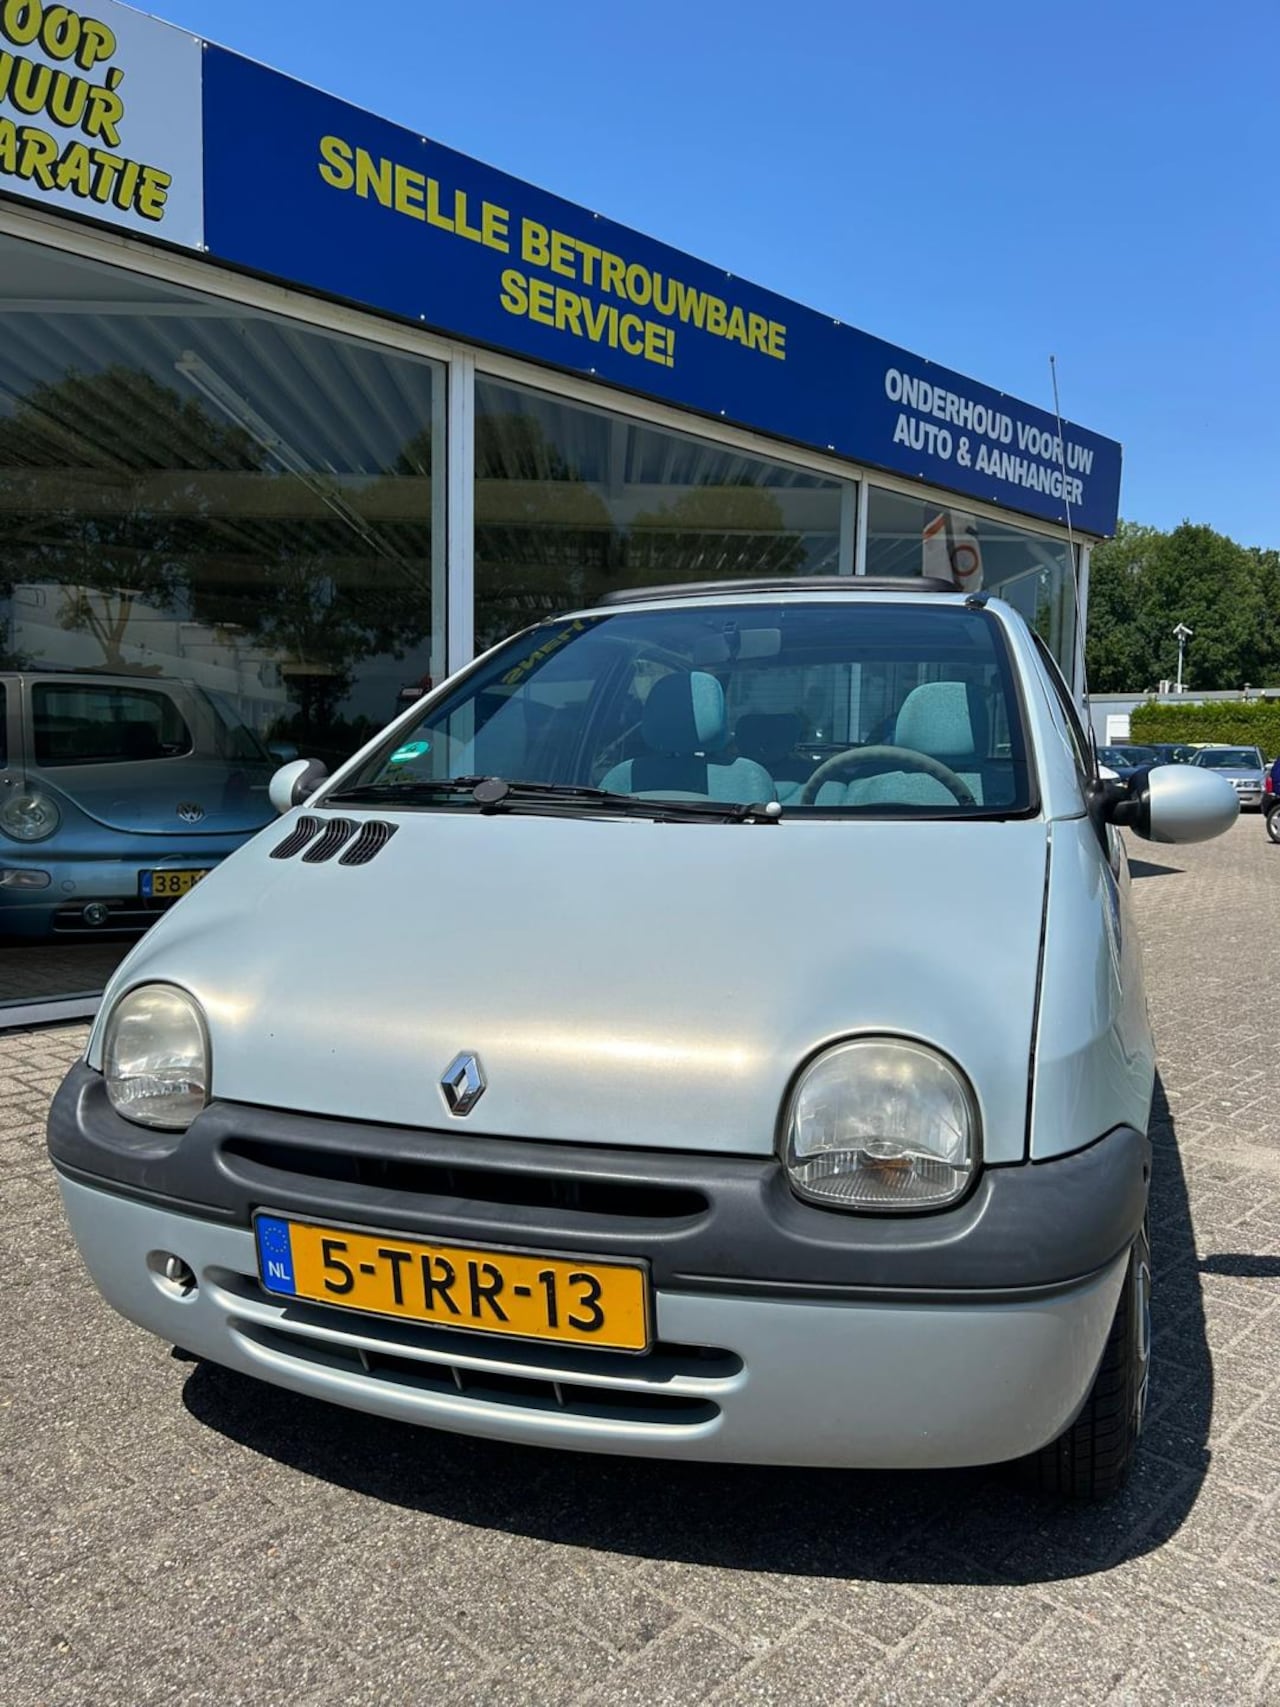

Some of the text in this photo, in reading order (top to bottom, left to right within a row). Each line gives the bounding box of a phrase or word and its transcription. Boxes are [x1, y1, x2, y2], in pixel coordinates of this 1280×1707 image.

[318, 135, 787, 362] SNELLE BETROUWBARE
[499, 268, 676, 369] SERVICE!
[884, 367, 1094, 475] ONDERHOUD VOOR UW
[893, 413, 1084, 506] AUTO & AANHANGER
[268, 1260, 291, 1281] NL
[321, 1238, 606, 1332] 5-TRR-13
